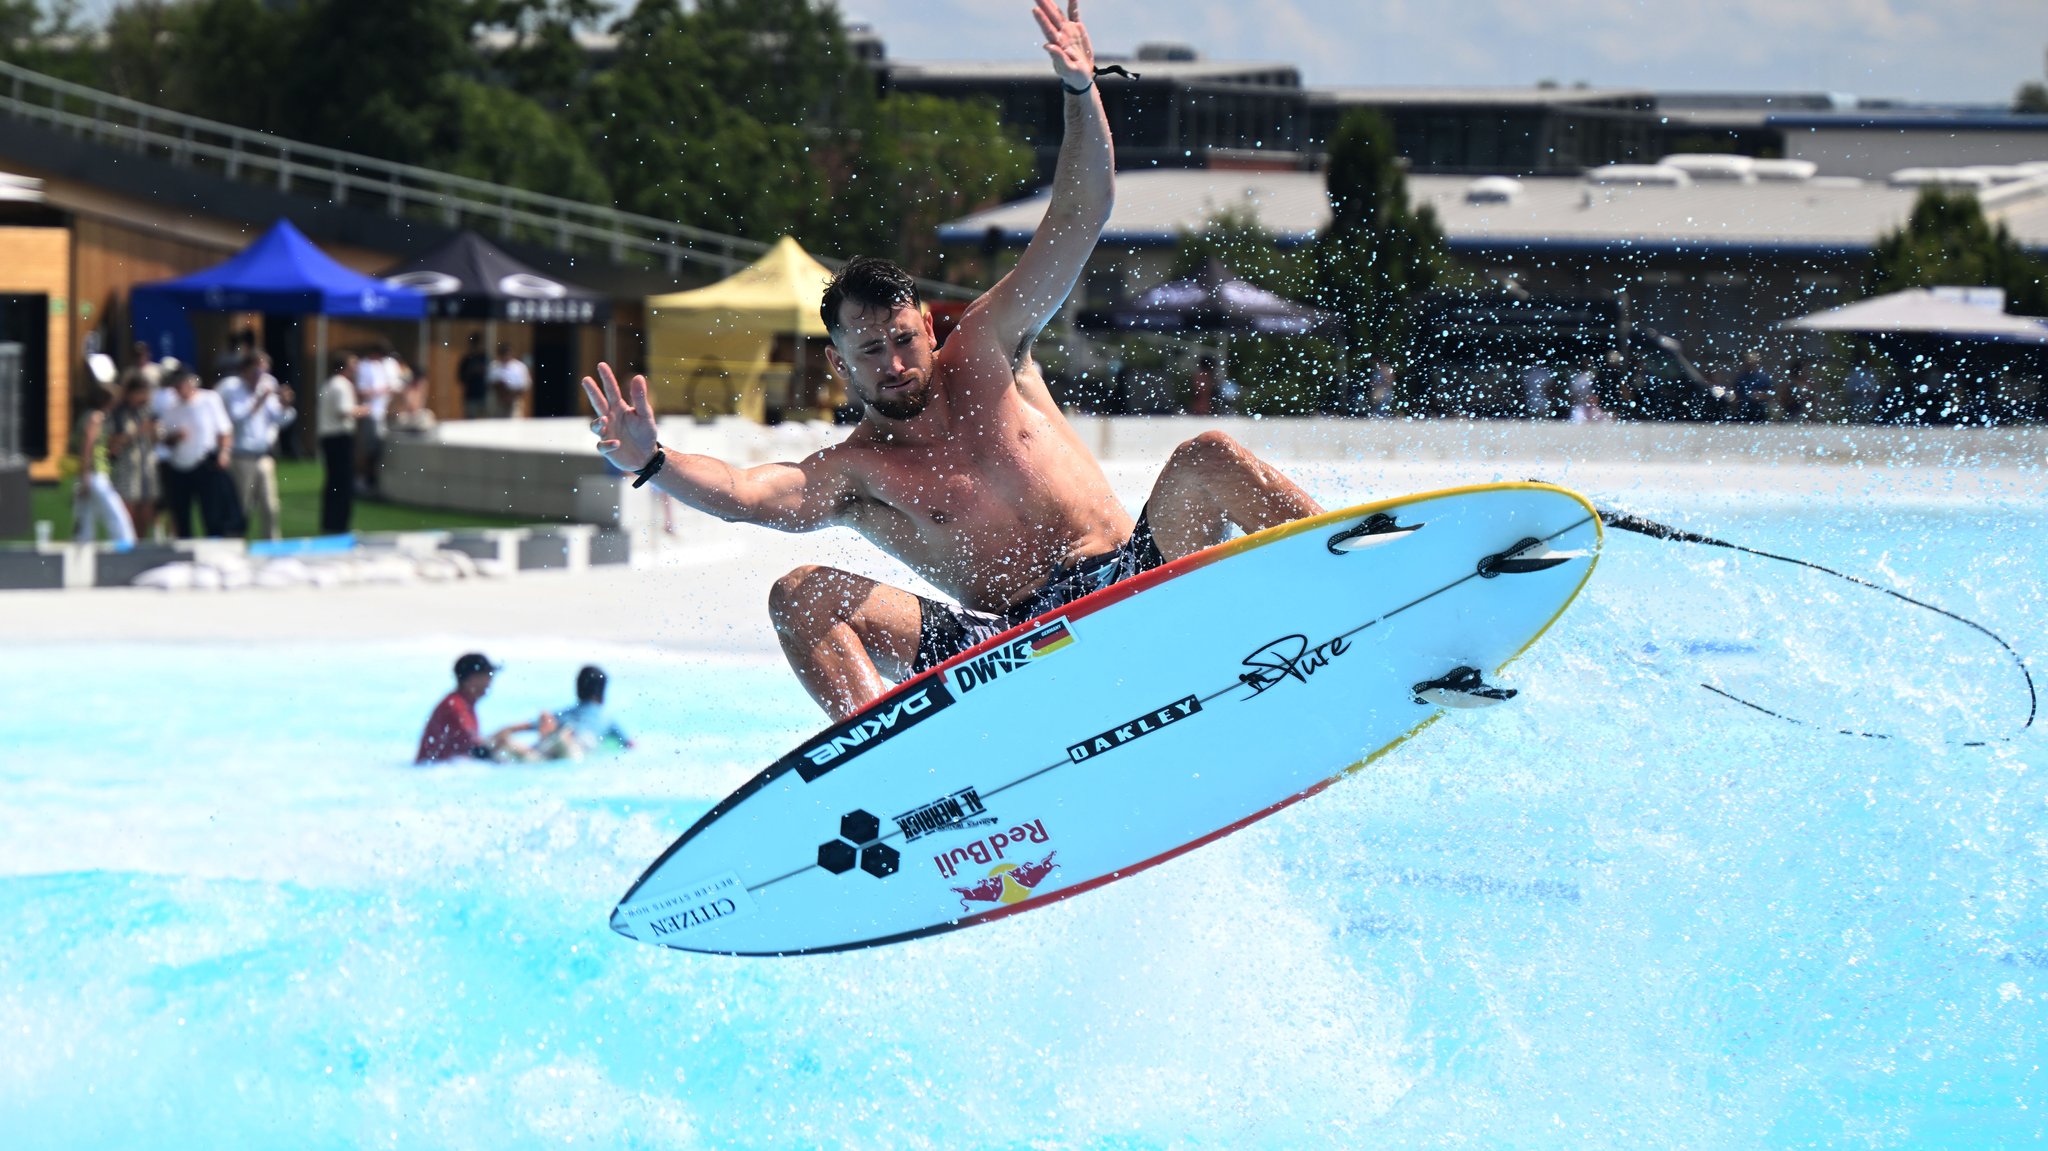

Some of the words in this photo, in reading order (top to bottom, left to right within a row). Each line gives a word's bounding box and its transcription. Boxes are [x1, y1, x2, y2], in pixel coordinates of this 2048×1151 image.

[1041, 624, 1062, 636] GERMANY
[1241, 634, 1352, 686] Pure
[803, 687, 932, 766] DAKINE
[1070, 699, 1192, 761] OAKLEY
[897, 798, 965, 840] MERRICK
[961, 789, 984, 813] AL
[933, 840, 993, 879] Bull
[988, 818, 1050, 860] Red
[650, 897, 736, 937] CITIZEN
[652, 894, 692, 911] STARTS
